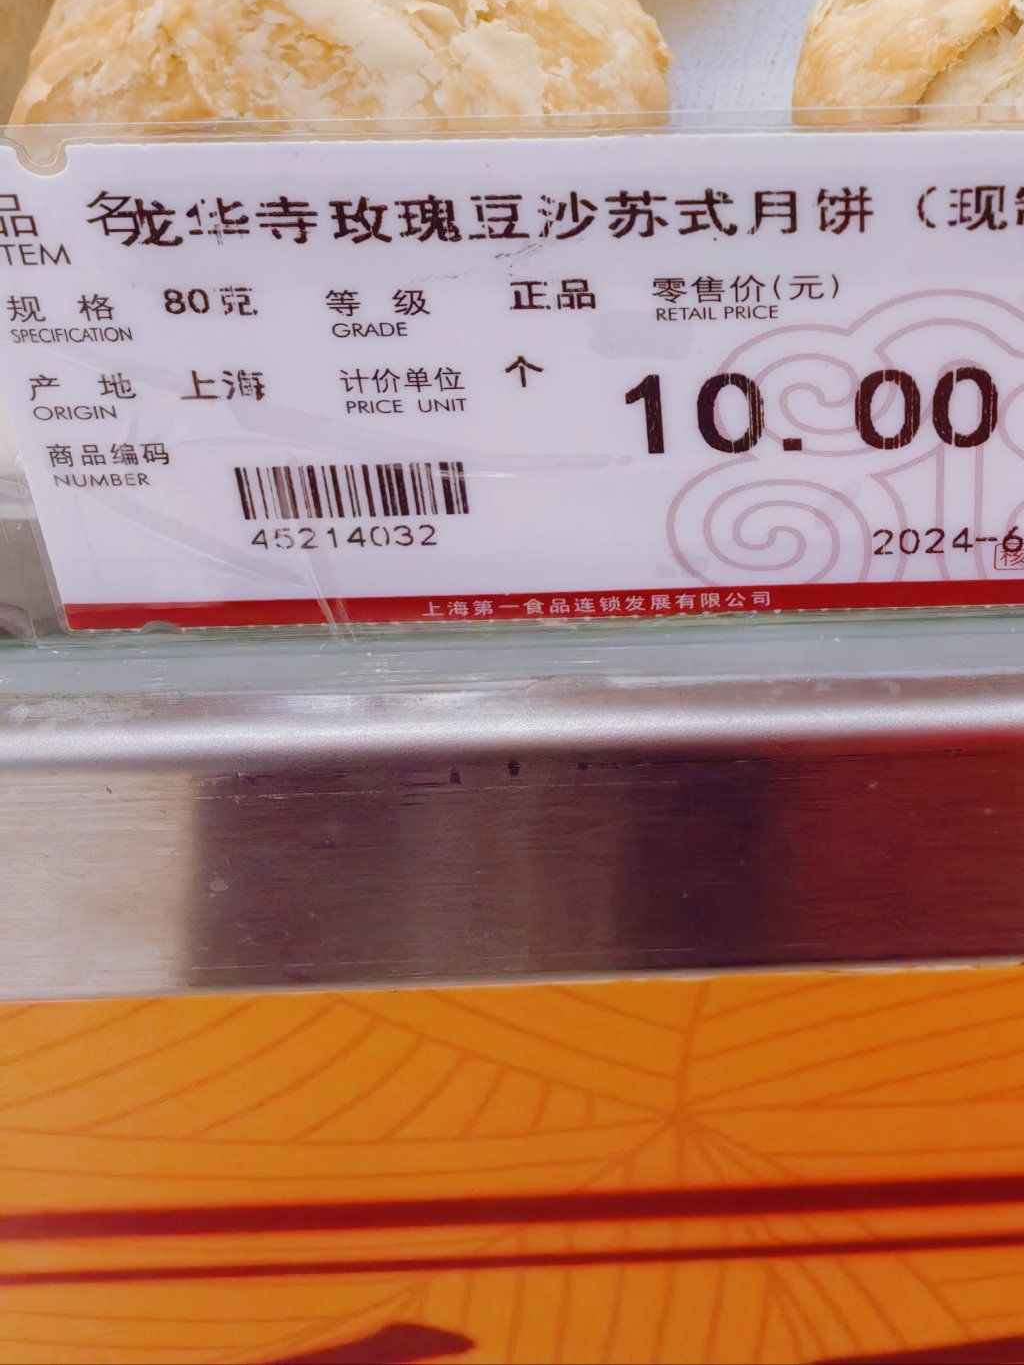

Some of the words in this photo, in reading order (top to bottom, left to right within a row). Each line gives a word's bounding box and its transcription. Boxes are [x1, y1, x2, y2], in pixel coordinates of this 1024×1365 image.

[0, 244, 71, 266] TEM
[509, 278, 596, 311] 正品
[656, 306, 717, 322] RETAIL
[724, 304, 780, 320] PRICE
[11, 326, 133, 343] SPECIFICATION
[332, 322, 408, 338] GRADE
[340, 368, 466, 394] 计价单位
[504, 355, 544, 389] 个
[180, 369, 266, 401] 上海
[33, 404, 117, 421] ORIGIN
[346, 399, 403, 415] PRICE
[418, 397, 467, 413] UNIT
[46, 442, 170, 467] 商品编码
[54, 472, 150, 487] NUMBER
[251, 524, 439, 551] 45214032
[422, 591, 772, 617] 上海第一食品连锁发展有限公司
